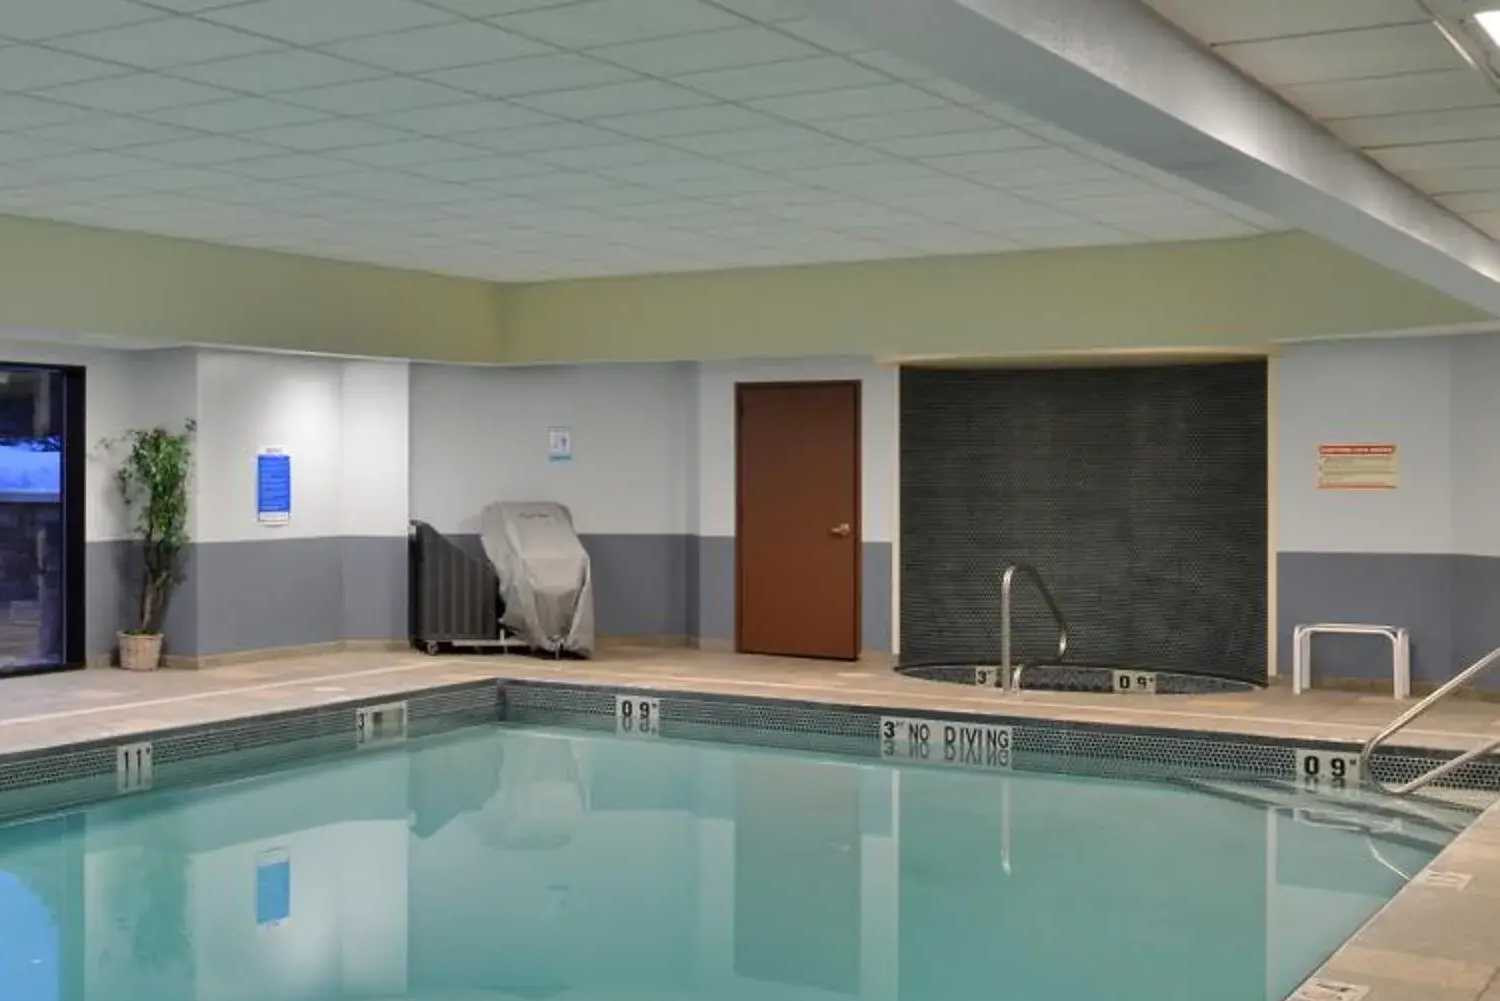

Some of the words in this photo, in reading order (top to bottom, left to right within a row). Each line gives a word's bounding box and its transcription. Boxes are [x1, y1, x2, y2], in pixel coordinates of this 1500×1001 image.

[883, 720, 895, 738] 3
[909, 723, 930, 742] NO
[944, 726, 1009, 749] DIVING
